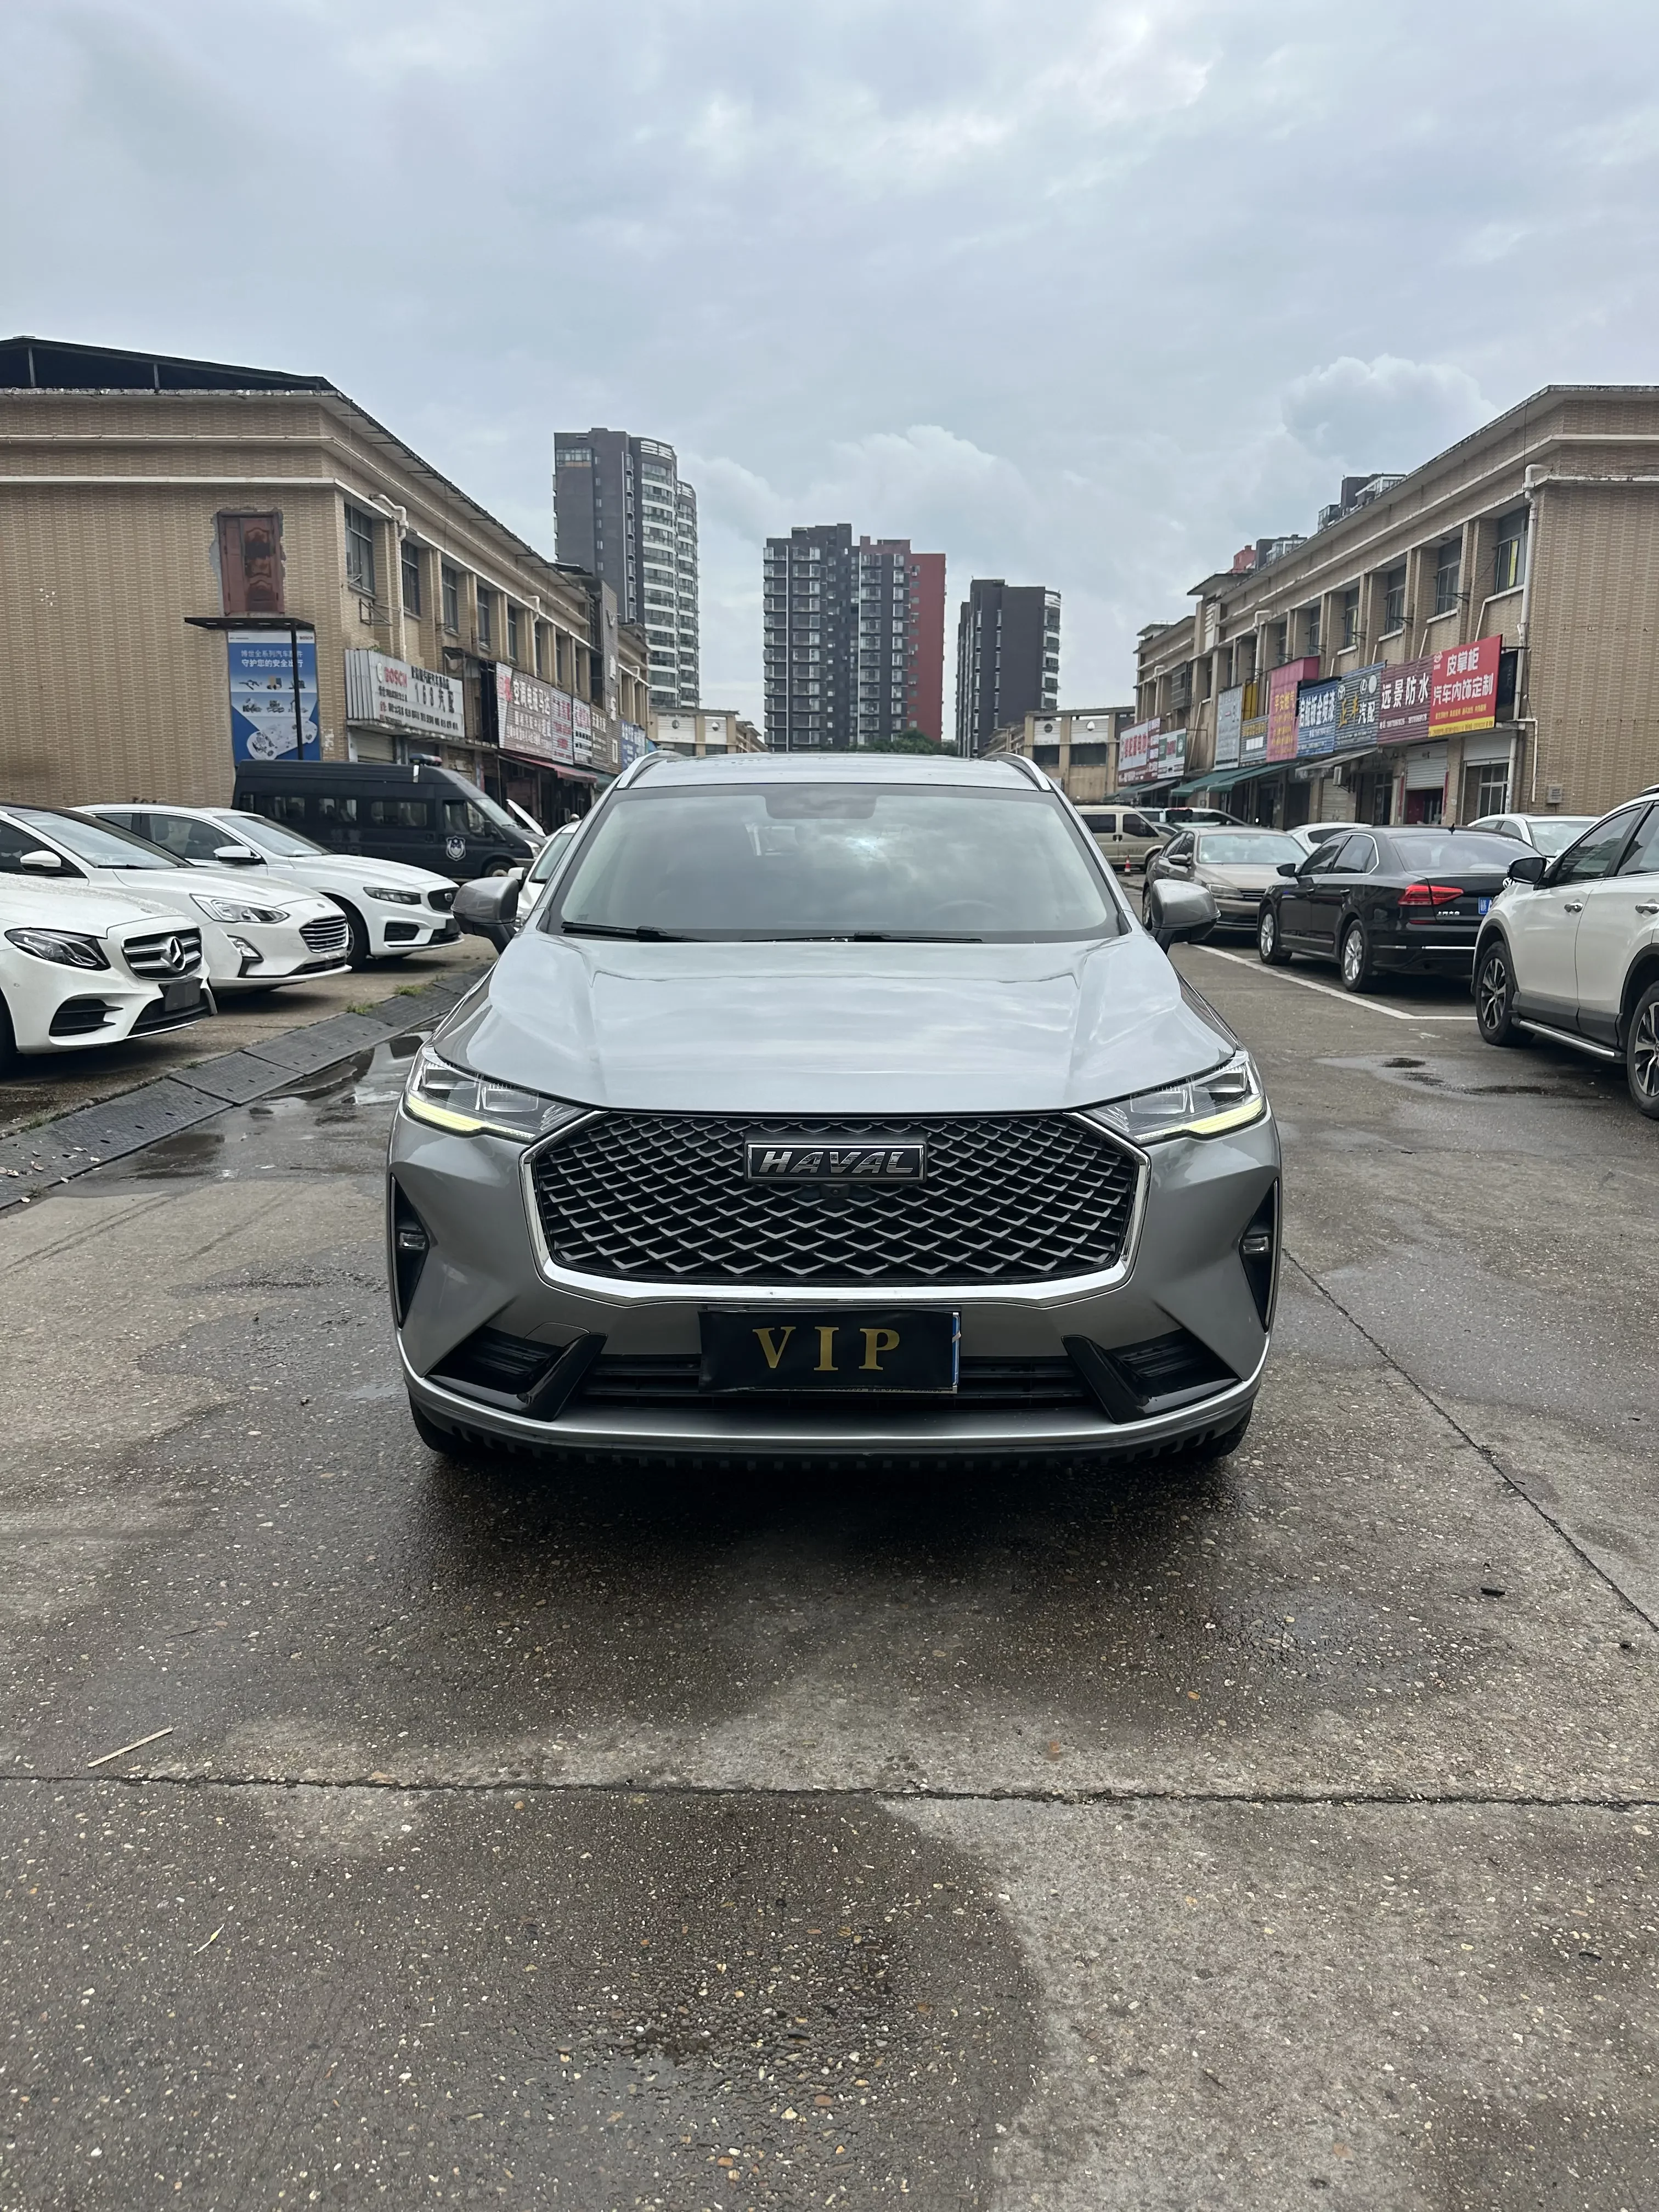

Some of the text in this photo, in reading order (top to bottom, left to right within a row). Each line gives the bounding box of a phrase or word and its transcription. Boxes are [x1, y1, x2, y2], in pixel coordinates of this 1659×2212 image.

[1446, 647, 1480, 677] 皮掌柜
[1381, 672, 1429, 710] 远景防水
[1432, 673, 1494, 707] 汽车内饰定制
[758, 1151, 915, 1174] HAVAL
[752, 1326, 901, 1372] VIP
